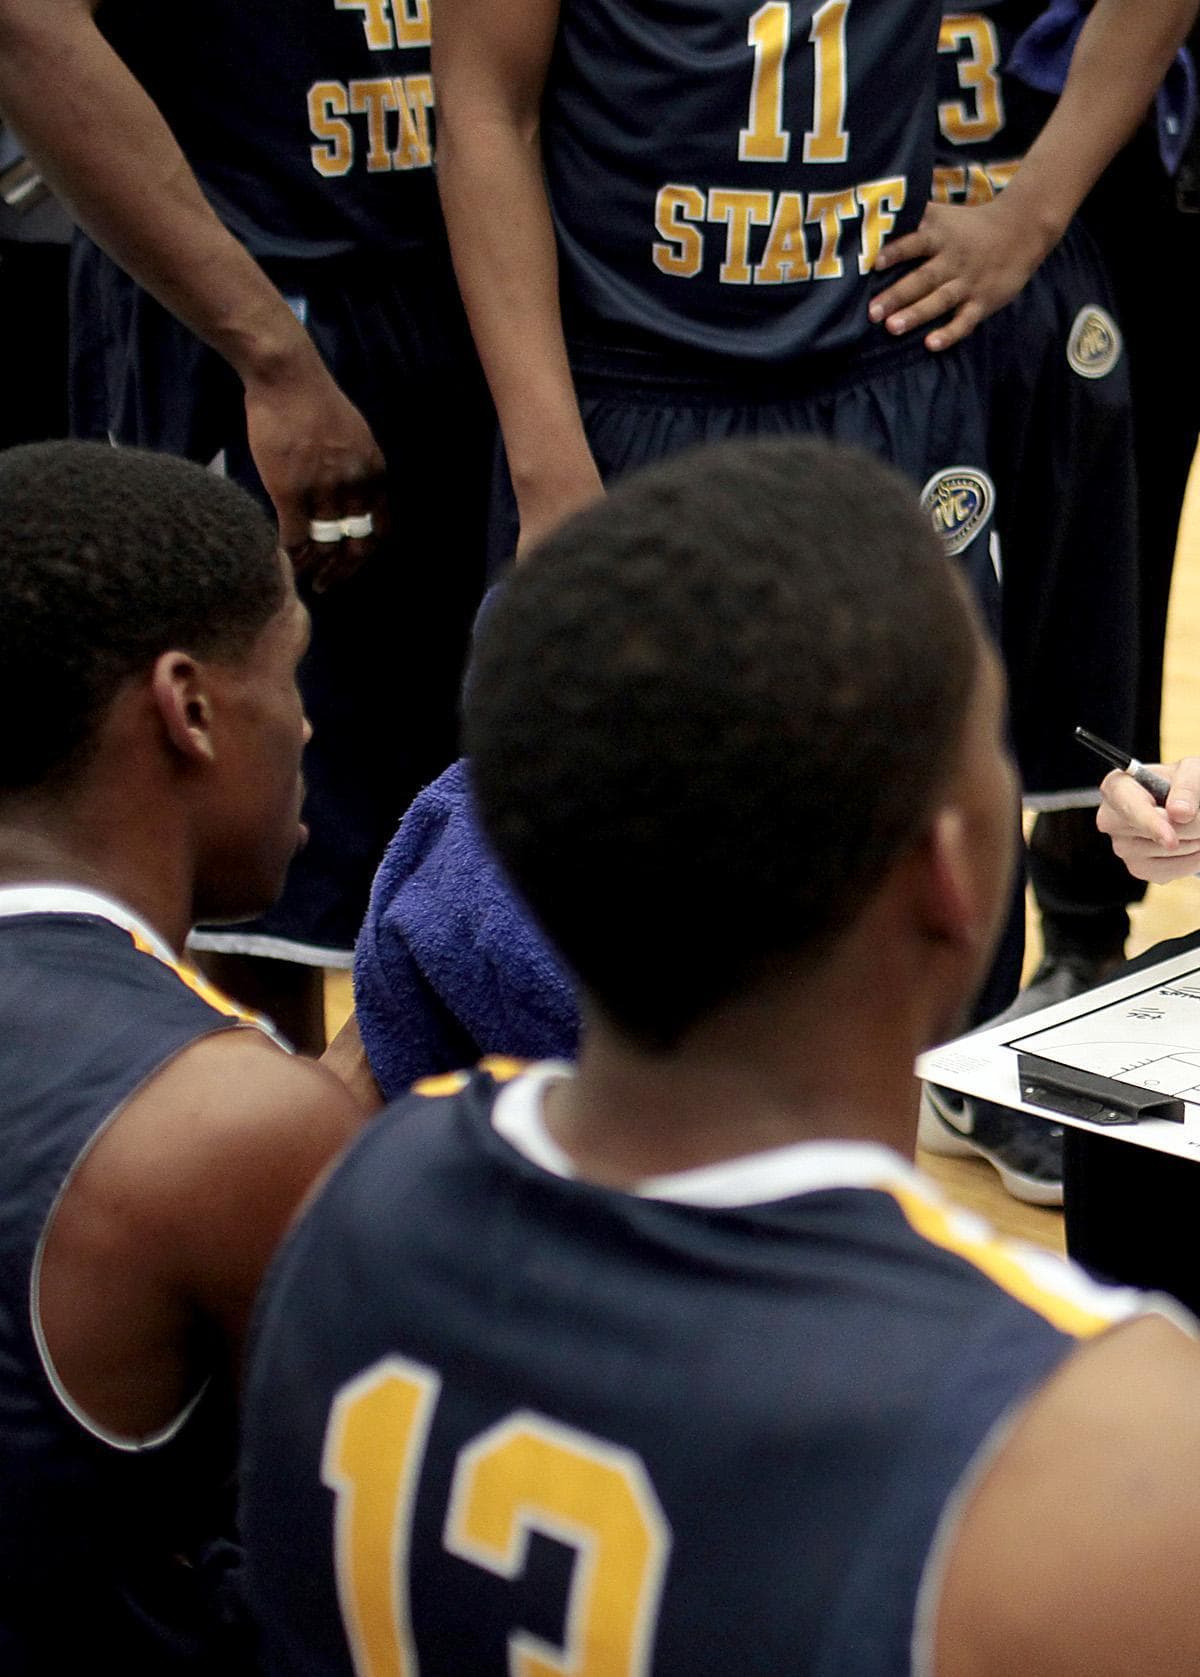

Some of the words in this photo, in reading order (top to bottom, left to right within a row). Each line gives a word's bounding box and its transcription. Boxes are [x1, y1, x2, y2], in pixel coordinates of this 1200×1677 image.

[738, 0, 849, 163] 11
[937, 13, 1005, 145] 3
[320, 1353, 674, 1677] 13
